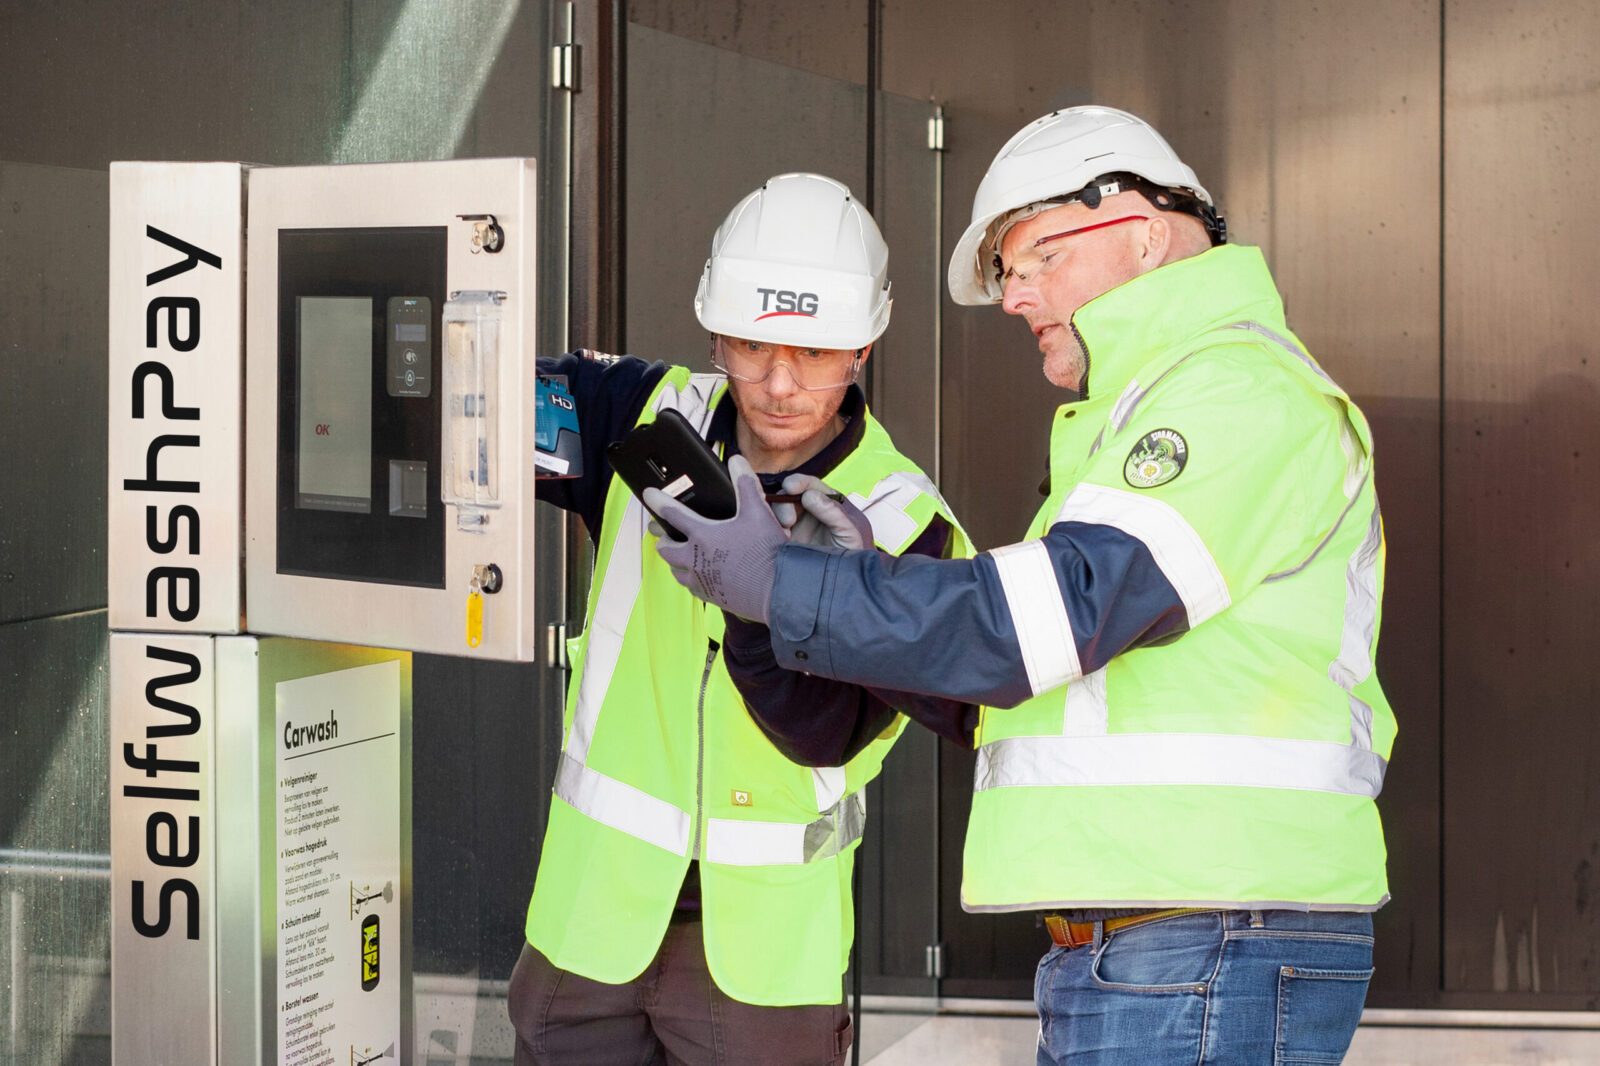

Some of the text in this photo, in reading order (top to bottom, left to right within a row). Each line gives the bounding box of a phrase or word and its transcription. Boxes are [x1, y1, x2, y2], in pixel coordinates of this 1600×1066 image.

[757, 288, 819, 316] TSG
[551, 394, 574, 411] HD
[315, 423, 330, 436] OK
[123, 224, 222, 941] SelfwashPay
[284, 709, 338, 750] Carwash
[284, 771, 318, 788] Velgenreiniger
[285, 837, 327, 858] Voorwas hogedruk
[285, 907, 321, 929] Schuim intensief
[285, 992, 319, 1011] Borstel wassen
